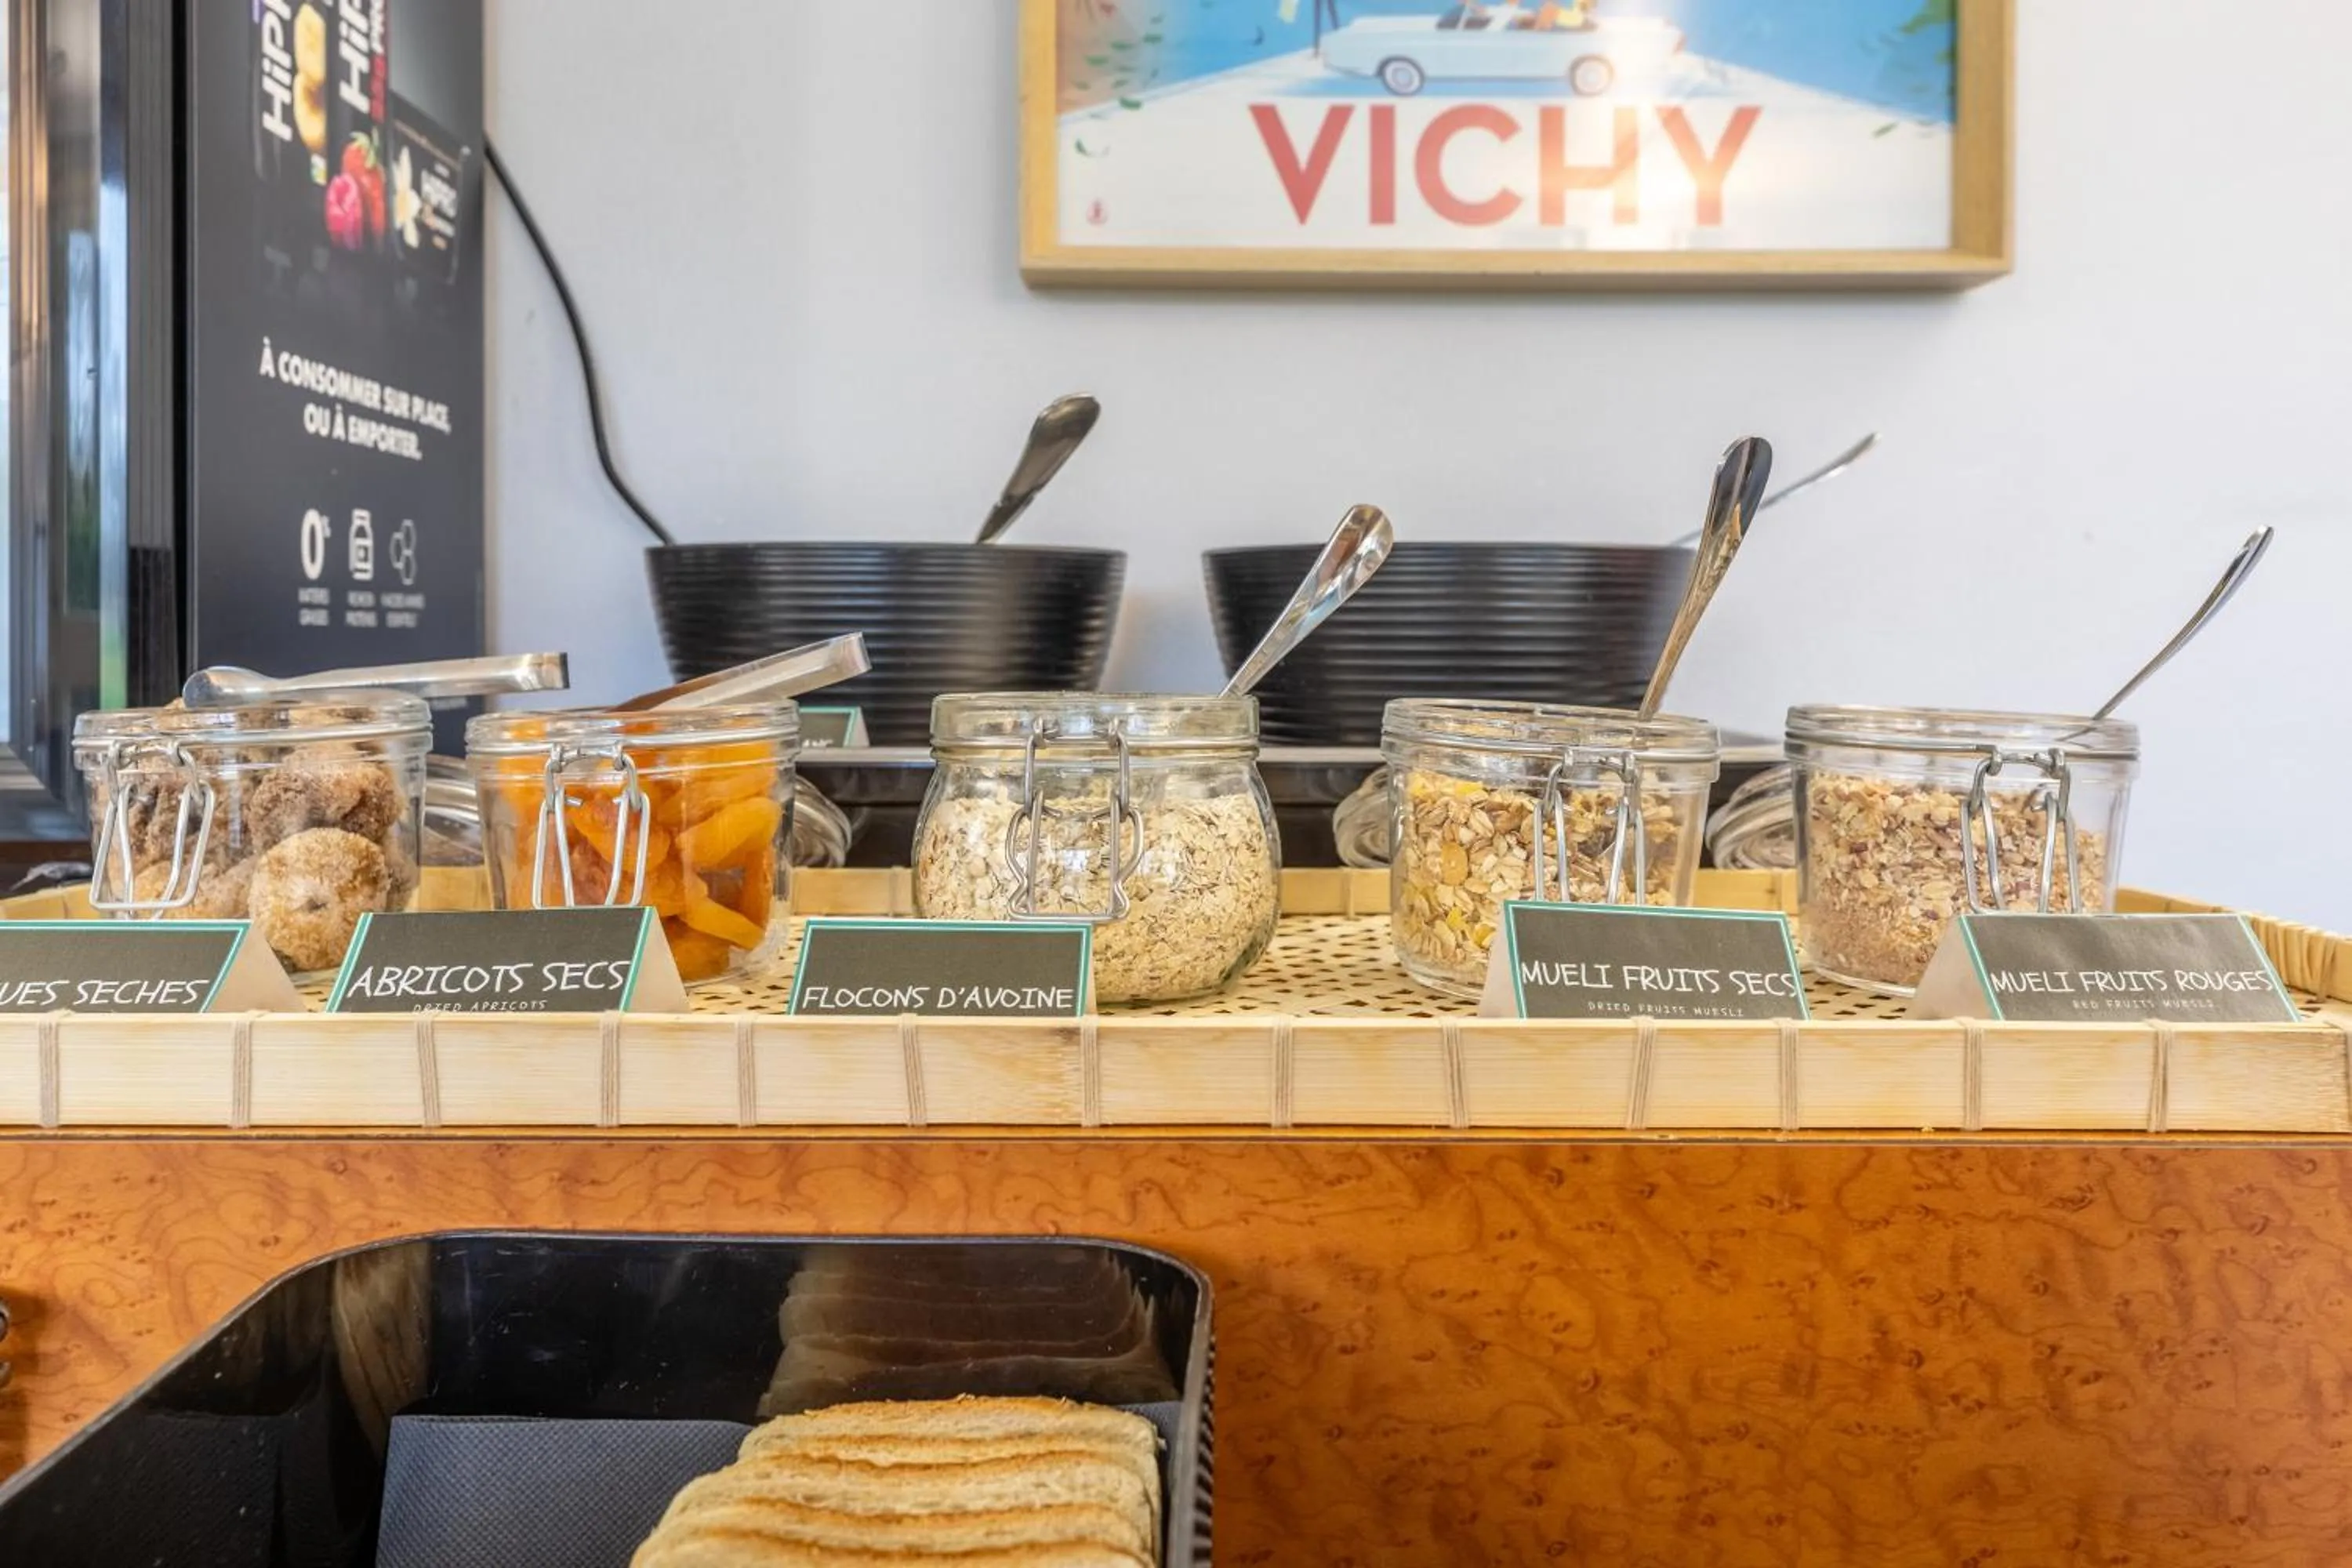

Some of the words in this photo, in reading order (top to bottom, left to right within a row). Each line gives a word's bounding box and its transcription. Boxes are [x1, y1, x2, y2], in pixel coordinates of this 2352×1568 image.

[1248, 103, 1764, 227] VICHY
[278, 350, 382, 412] CONSOMMER
[383, 385, 412, 420] SUR
[303, 402, 331, 437] OU
[73, 979, 210, 1005] SECHES
[347, 964, 534, 997] ABRICOTS
[543, 960, 630, 991] SECS
[1520, 960, 1614, 989] MUELI
[1622, 965, 1720, 994] FRUITS
[1729, 971, 1798, 999] SECS
[1990, 971, 2075, 994] MUELI
[2080, 970, 2168, 993] FRUITS
[2174, 969, 2273, 993] ROUGES
[470, 1000, 548, 1011] APRICOTS
[802, 985, 931, 1009] FLOCONS
[937, 985, 1075, 1009] D'AVOINE
[1588, 1000, 1631, 1012] DRIED
[1638, 1003, 1686, 1014] FRUITS
